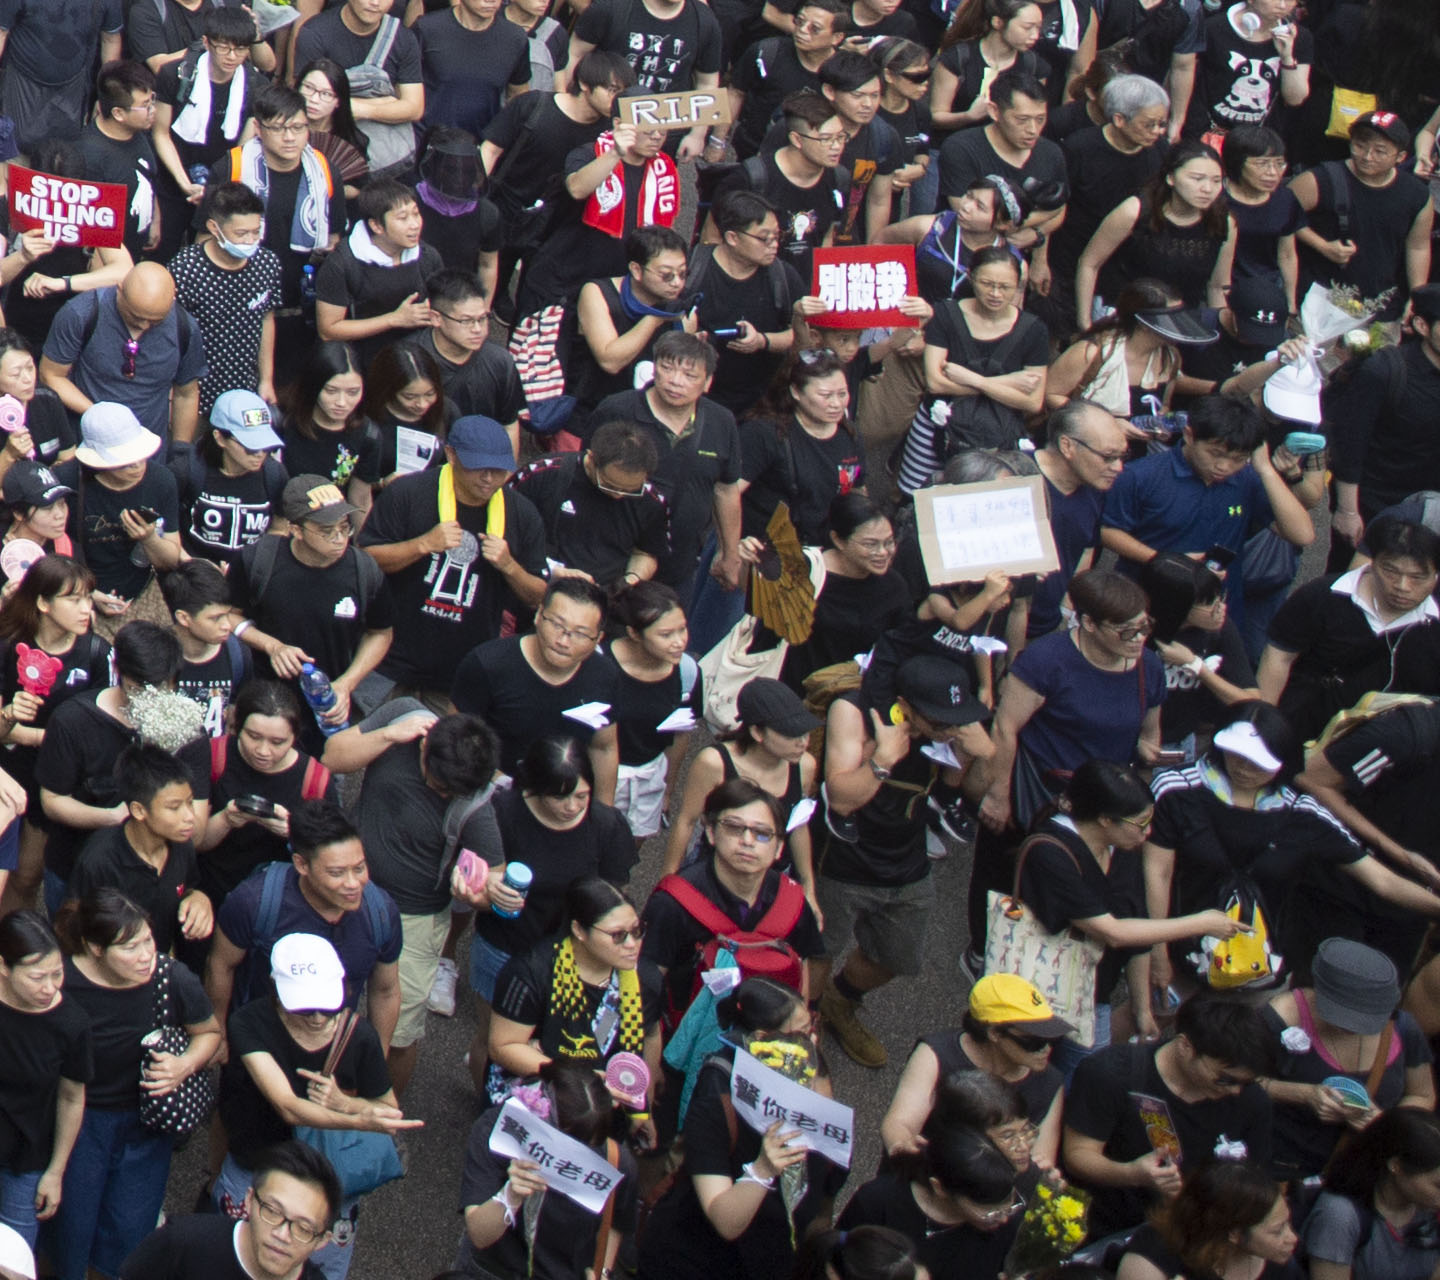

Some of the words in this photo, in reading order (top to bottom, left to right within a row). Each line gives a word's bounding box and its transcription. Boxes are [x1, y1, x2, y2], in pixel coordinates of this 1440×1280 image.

[630, 95, 719, 127] R.I.P.
[30, 175, 100, 209] STOP
[14, 193, 114, 230] KILLING
[43, 220, 81, 245] US
[819, 263, 909, 314] 別殺我
[734, 1074, 850, 1146] 警你老母
[500, 1115, 613, 1192] 警你老母
